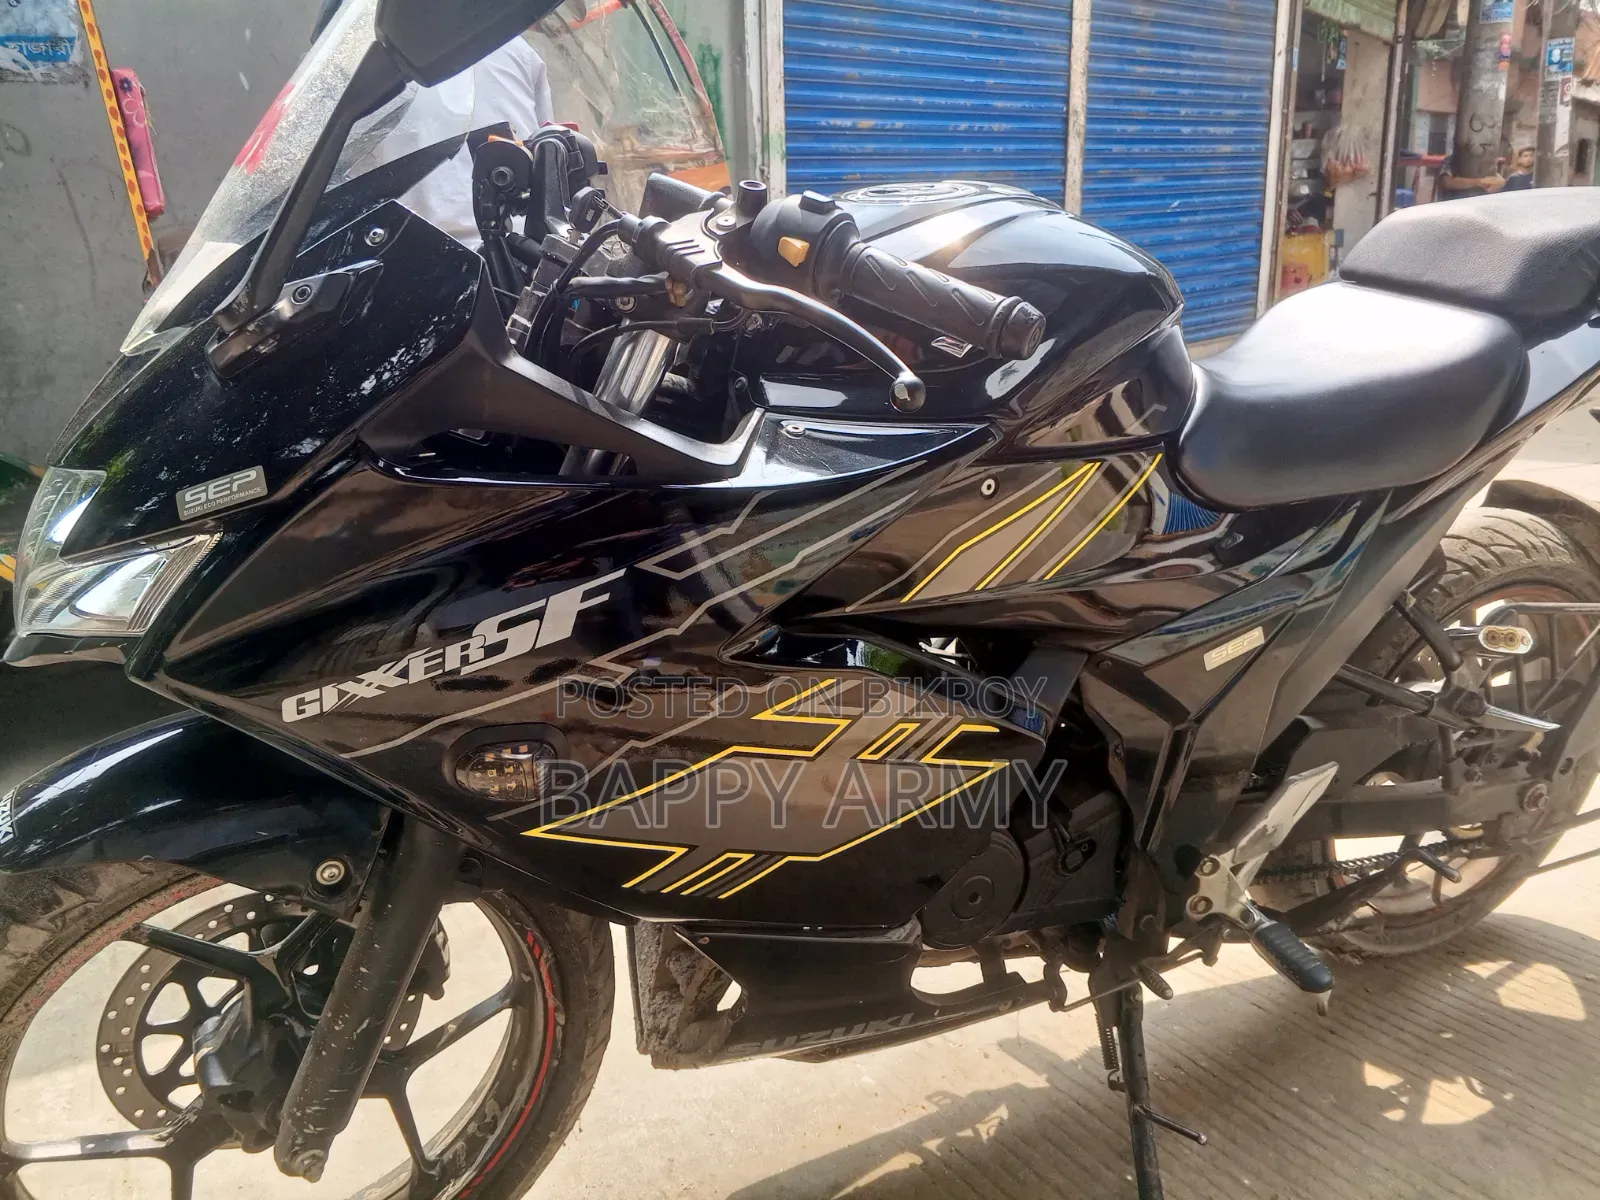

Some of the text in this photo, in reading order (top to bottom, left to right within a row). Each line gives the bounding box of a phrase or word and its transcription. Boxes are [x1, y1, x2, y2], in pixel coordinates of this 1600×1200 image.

[183, 487, 262, 516] SUZUKI ECO PERFORMANCE
[185, 470, 257, 509] SEP
[1211, 631, 1260, 663] SEP
